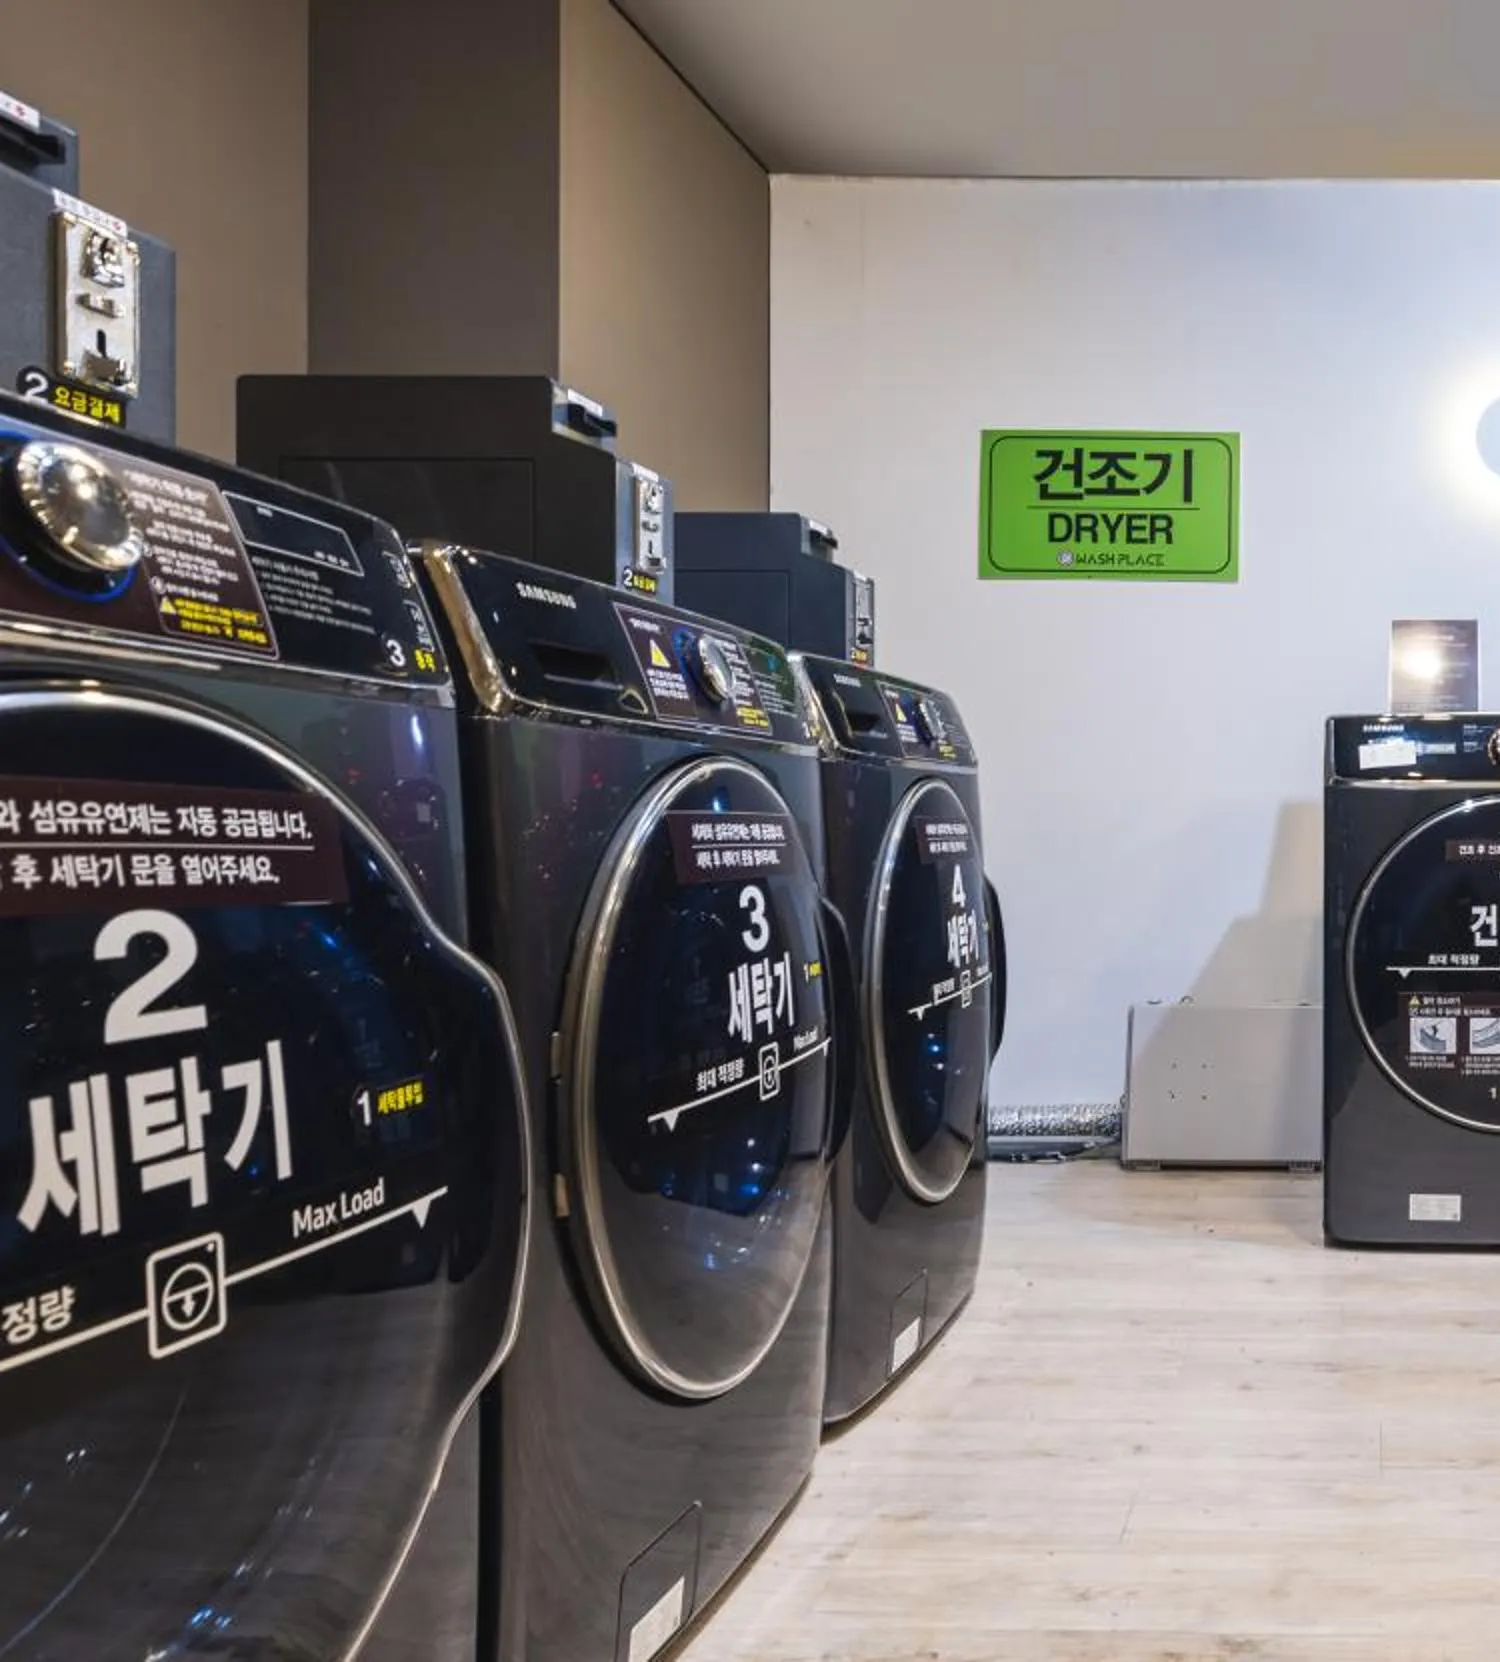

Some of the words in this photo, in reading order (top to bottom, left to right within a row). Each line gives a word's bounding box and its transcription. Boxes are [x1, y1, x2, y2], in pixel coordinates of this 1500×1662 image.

[25, 372, 49, 403] 2
[54, 386, 120, 423] 요금결제
[1034, 447, 1193, 504] 건조기
[1048, 512, 1174, 545] DRYER
[1075, 552, 1114, 566] WASH
[1117, 552, 1166, 567] PLACE
[516, 581, 577, 609] SAMSUNG
[386, 638, 406, 667] 3
[29, 799, 172, 835] 섬유유연제는
[177, 804, 219, 838] 자동
[221, 808, 313, 840] 공급됩니다.
[11, 854, 42, 890] 후
[50, 854, 126, 889] 세탁기
[130, 857, 176, 887] 문을
[180, 855, 280, 885] 열어주세요.
[952, 864, 967, 908] 4
[739, 885, 771, 952] 3
[947, 909, 980, 969] 세탁기
[94, 908, 209, 1046] 2
[728, 951, 795, 1043] 세탁기
[357, 1090, 371, 1126] 1
[16, 1039, 293, 1237] 세탁기
[292, 1206, 338, 1239] Max
[340, 1176, 386, 1220] Load
